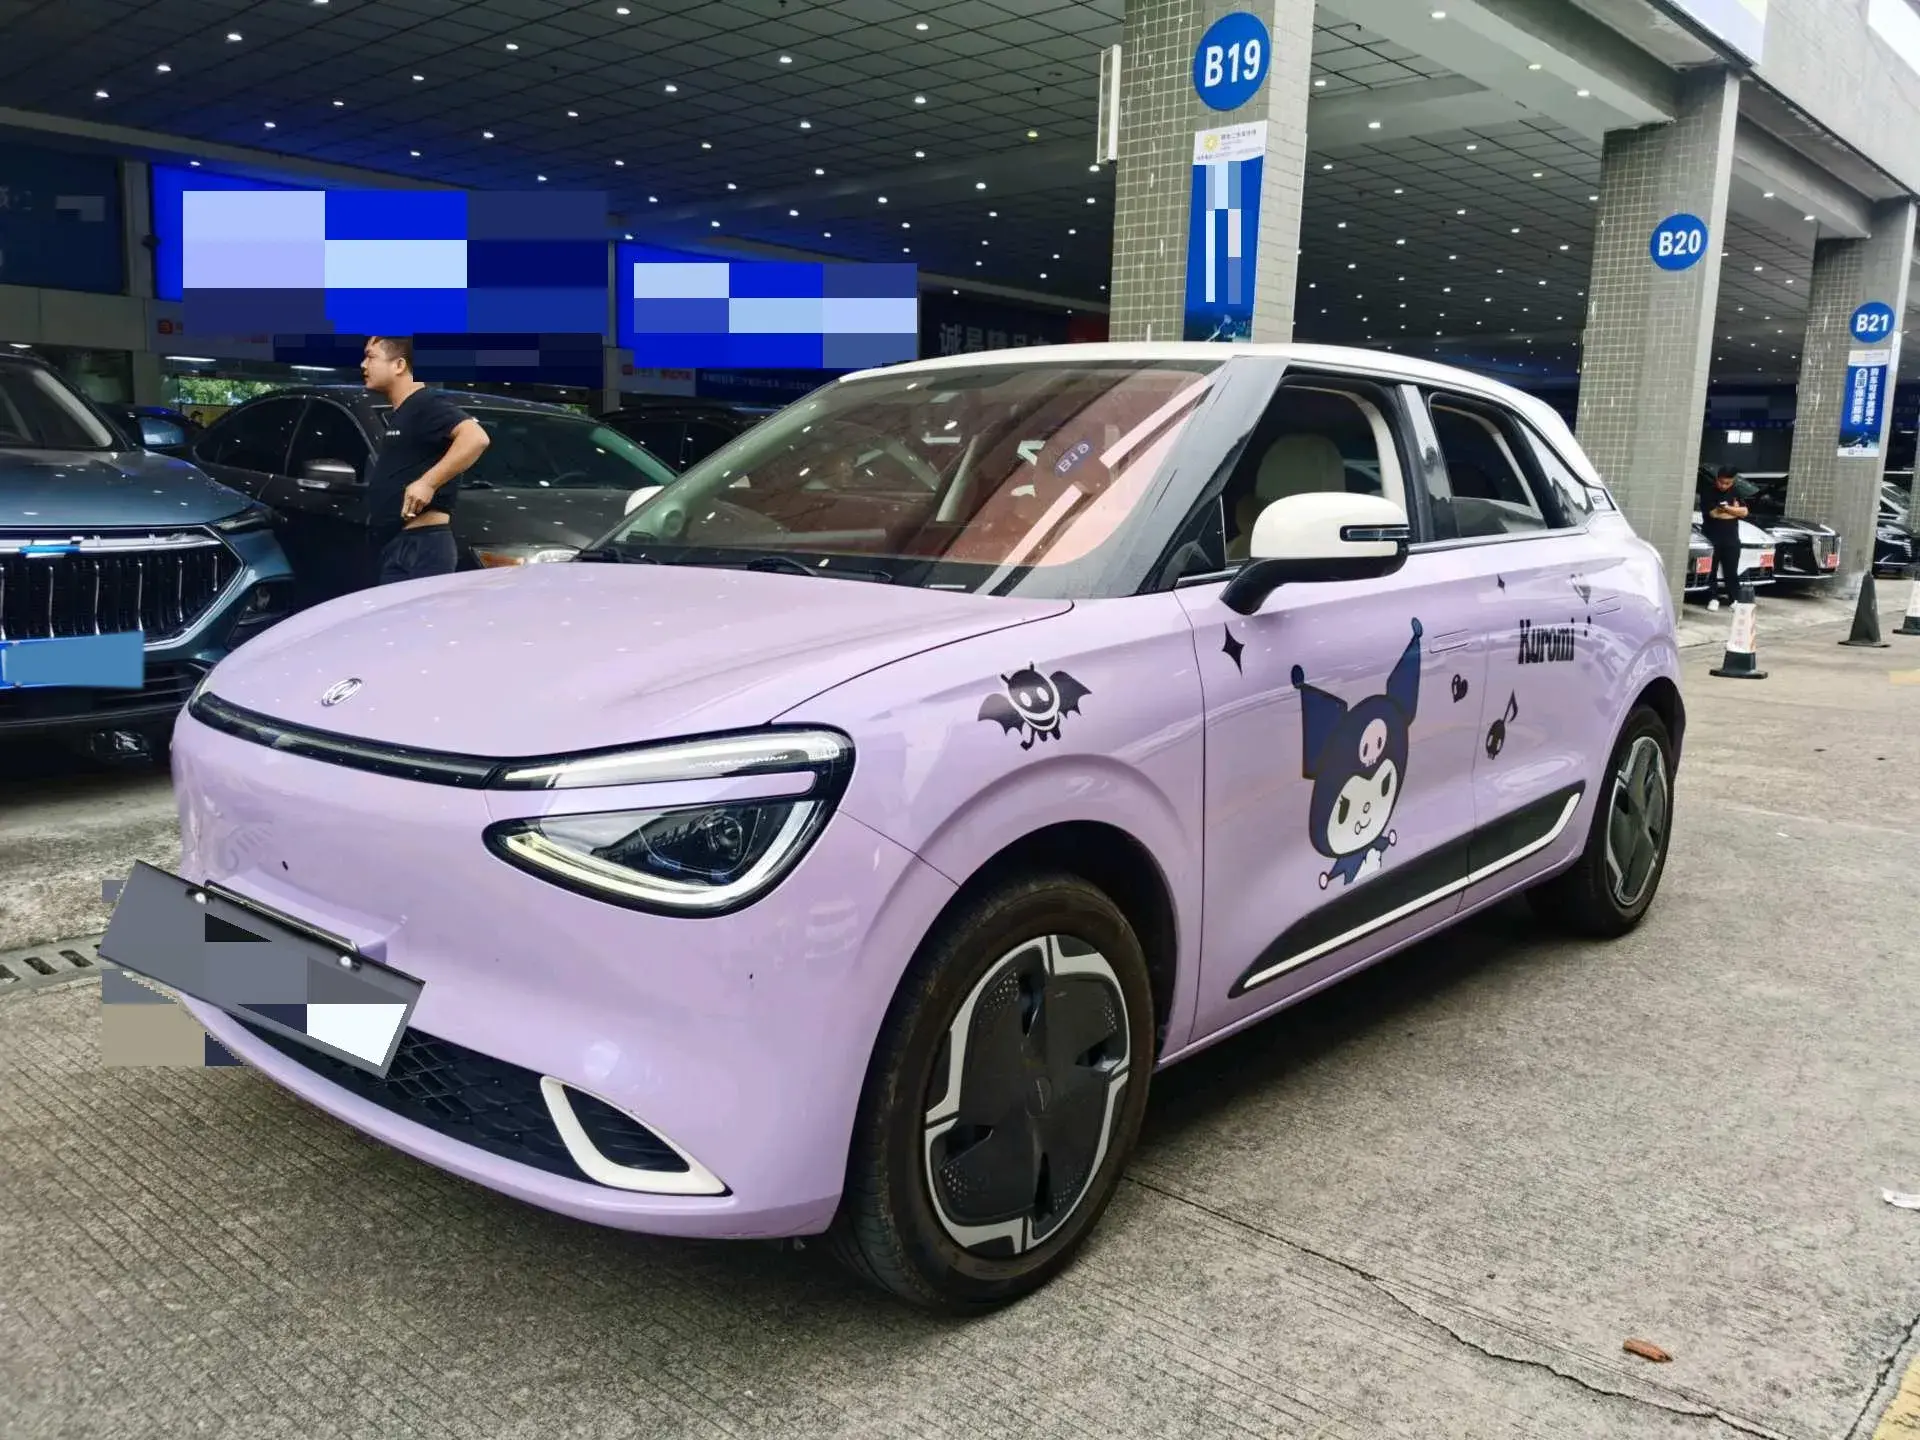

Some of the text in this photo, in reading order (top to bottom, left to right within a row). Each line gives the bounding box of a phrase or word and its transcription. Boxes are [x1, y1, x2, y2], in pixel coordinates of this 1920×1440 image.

[1204, 39, 1261, 88] B19
[1658, 230, 1701, 256] B20
[1856, 314, 1889, 333] B21
[1518, 617, 1575, 664] Kuromi
